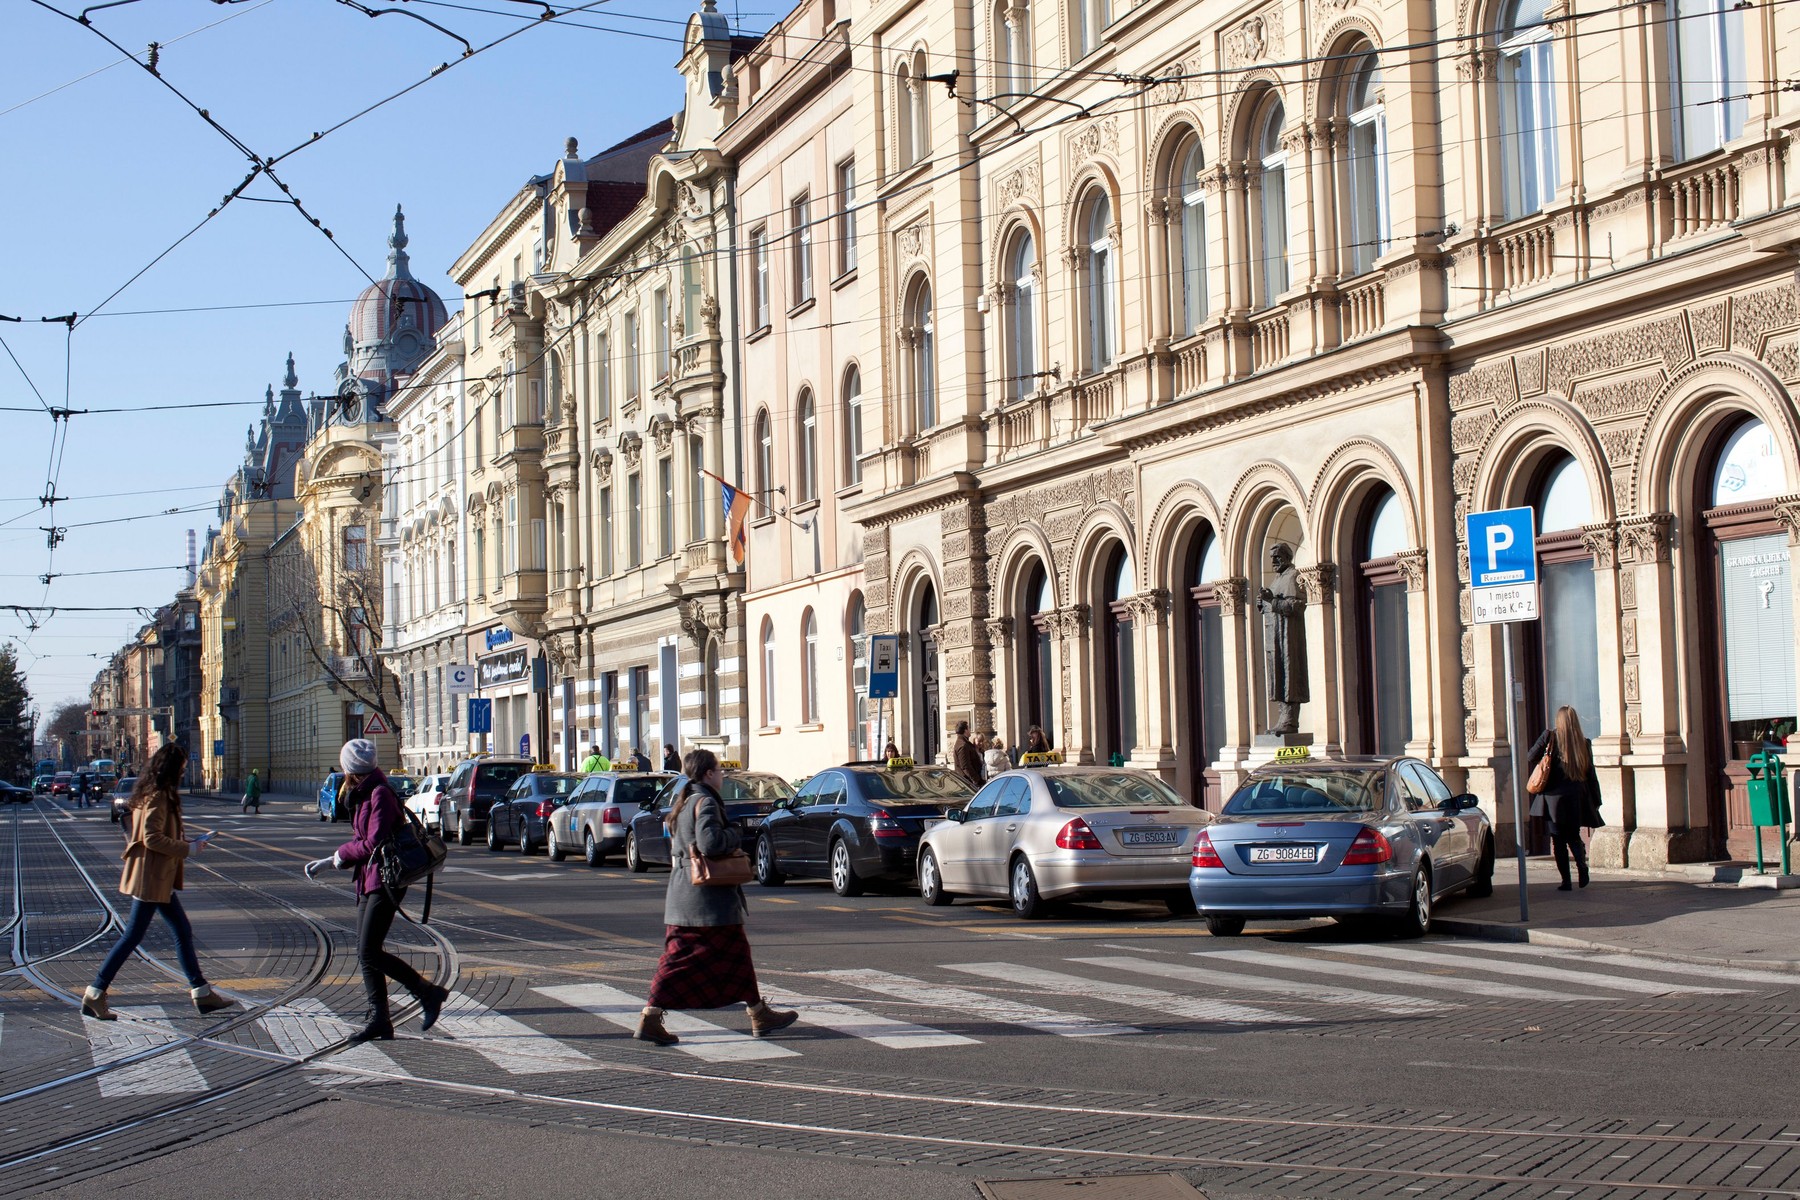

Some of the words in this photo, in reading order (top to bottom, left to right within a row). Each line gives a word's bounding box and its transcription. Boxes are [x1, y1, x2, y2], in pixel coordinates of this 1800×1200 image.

[363, 486, 371, 497] 5
[1486, 524, 1514, 570] P
[1726, 554, 1762, 567] GRADSKA
[1749, 565, 1781, 577] ZAGREB
[1483, 573, 1523, 582] Rezervirano
[1495, 591, 1520, 602] mjesto
[1477, 605, 1507, 618] Oprba
[879, 643, 891, 651] Taxi
[1279, 747, 1305, 756] TAXI
[892, 757, 912, 765] TAXI
[1027, 754, 1057, 763] TAXI
[1129, 833, 1140, 843] ZG
[1257, 849, 1269, 860] ZG
